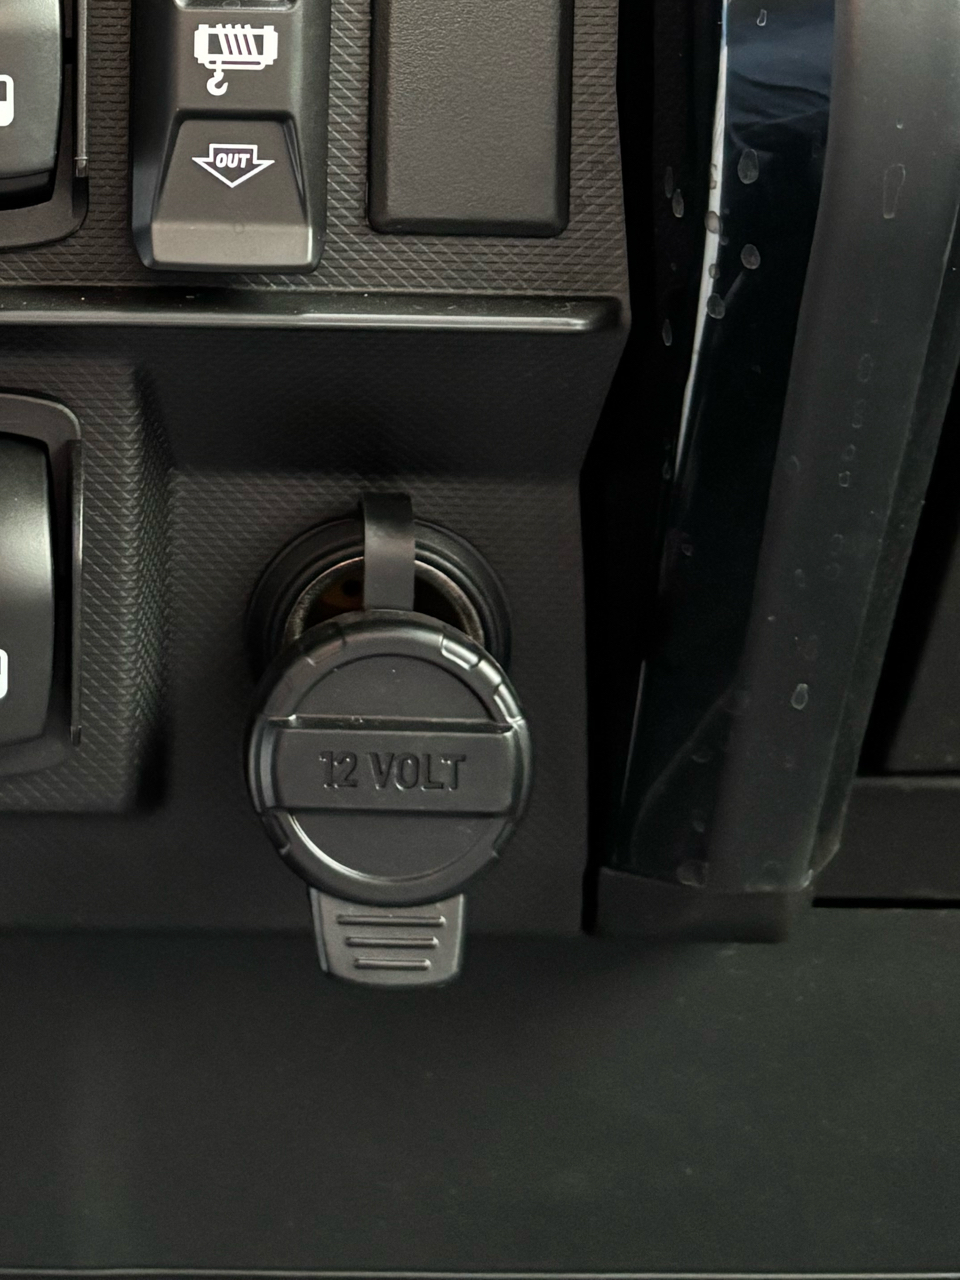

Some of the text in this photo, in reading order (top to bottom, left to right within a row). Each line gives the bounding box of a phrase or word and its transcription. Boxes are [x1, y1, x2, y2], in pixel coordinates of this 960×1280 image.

[215, 152, 251, 169] OUT
[319, 749, 467, 791] 12 VOLT
